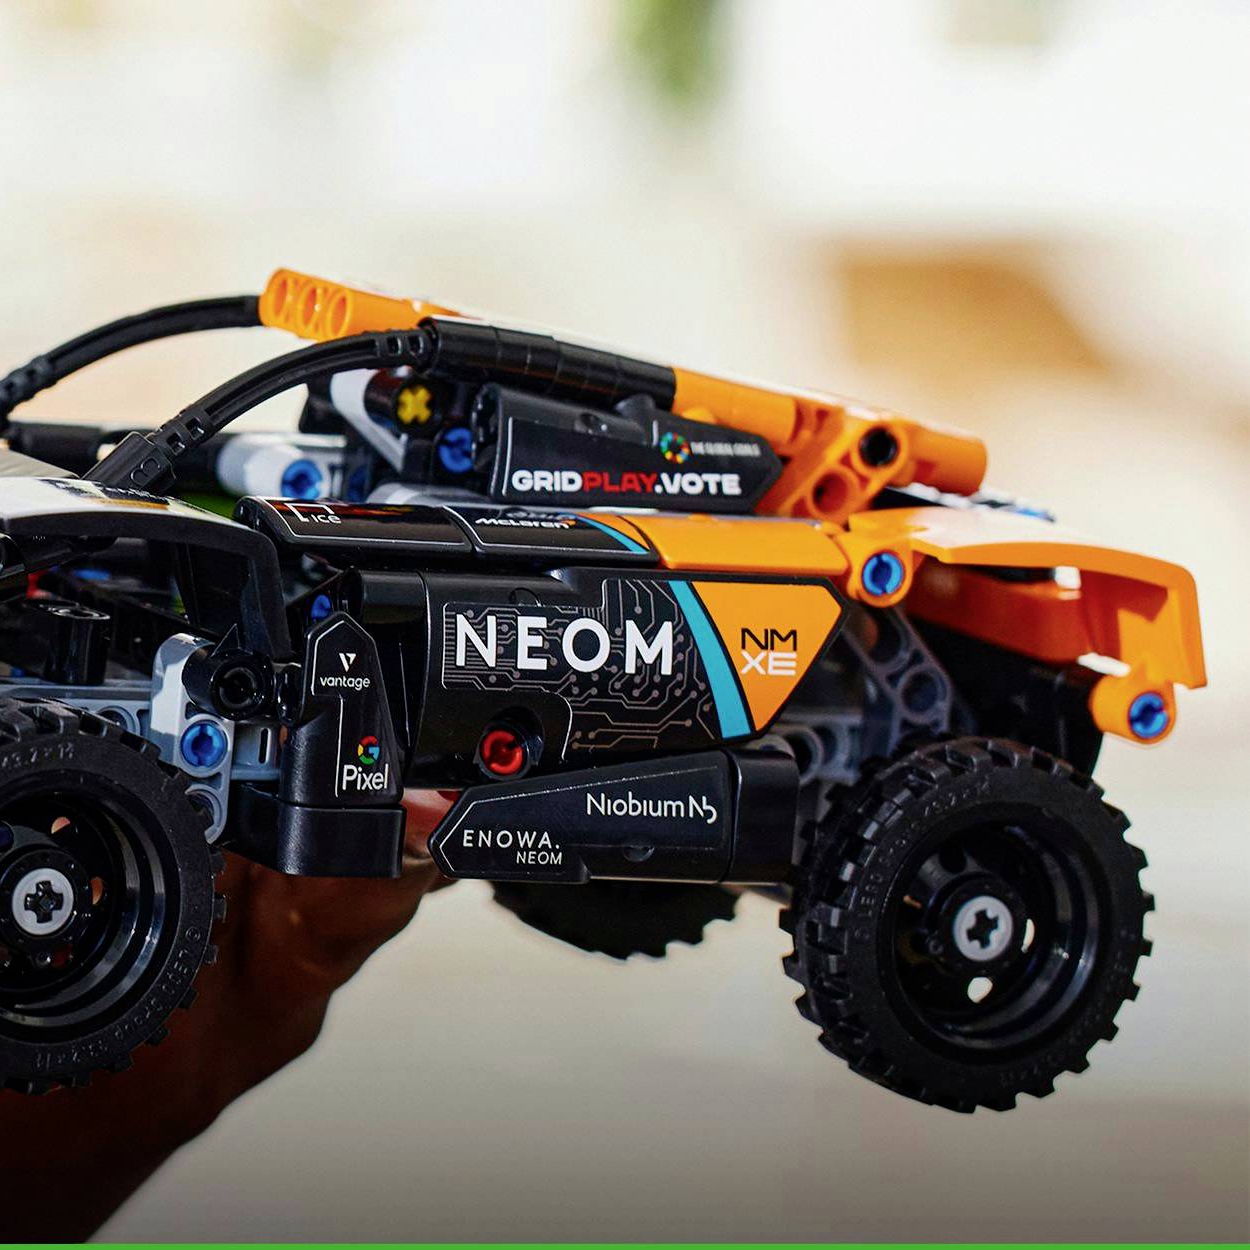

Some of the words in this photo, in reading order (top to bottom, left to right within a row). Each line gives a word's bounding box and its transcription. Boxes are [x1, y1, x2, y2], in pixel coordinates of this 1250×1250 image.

[511, 469, 742, 496] GRIDPLAY.VOTE
[476, 518, 570, 529] McLaren
[456, 614, 673, 675] NEOM
[741, 628, 797, 652] NM
[740, 651, 797, 675] XE
[319, 675, 370, 690] vantage
[342, 764, 389, 791] Pixel
[586, 791, 684, 818] Niobium
[462, 829, 561, 850] ENOWA.
[516, 851, 563, 866] NEOM
